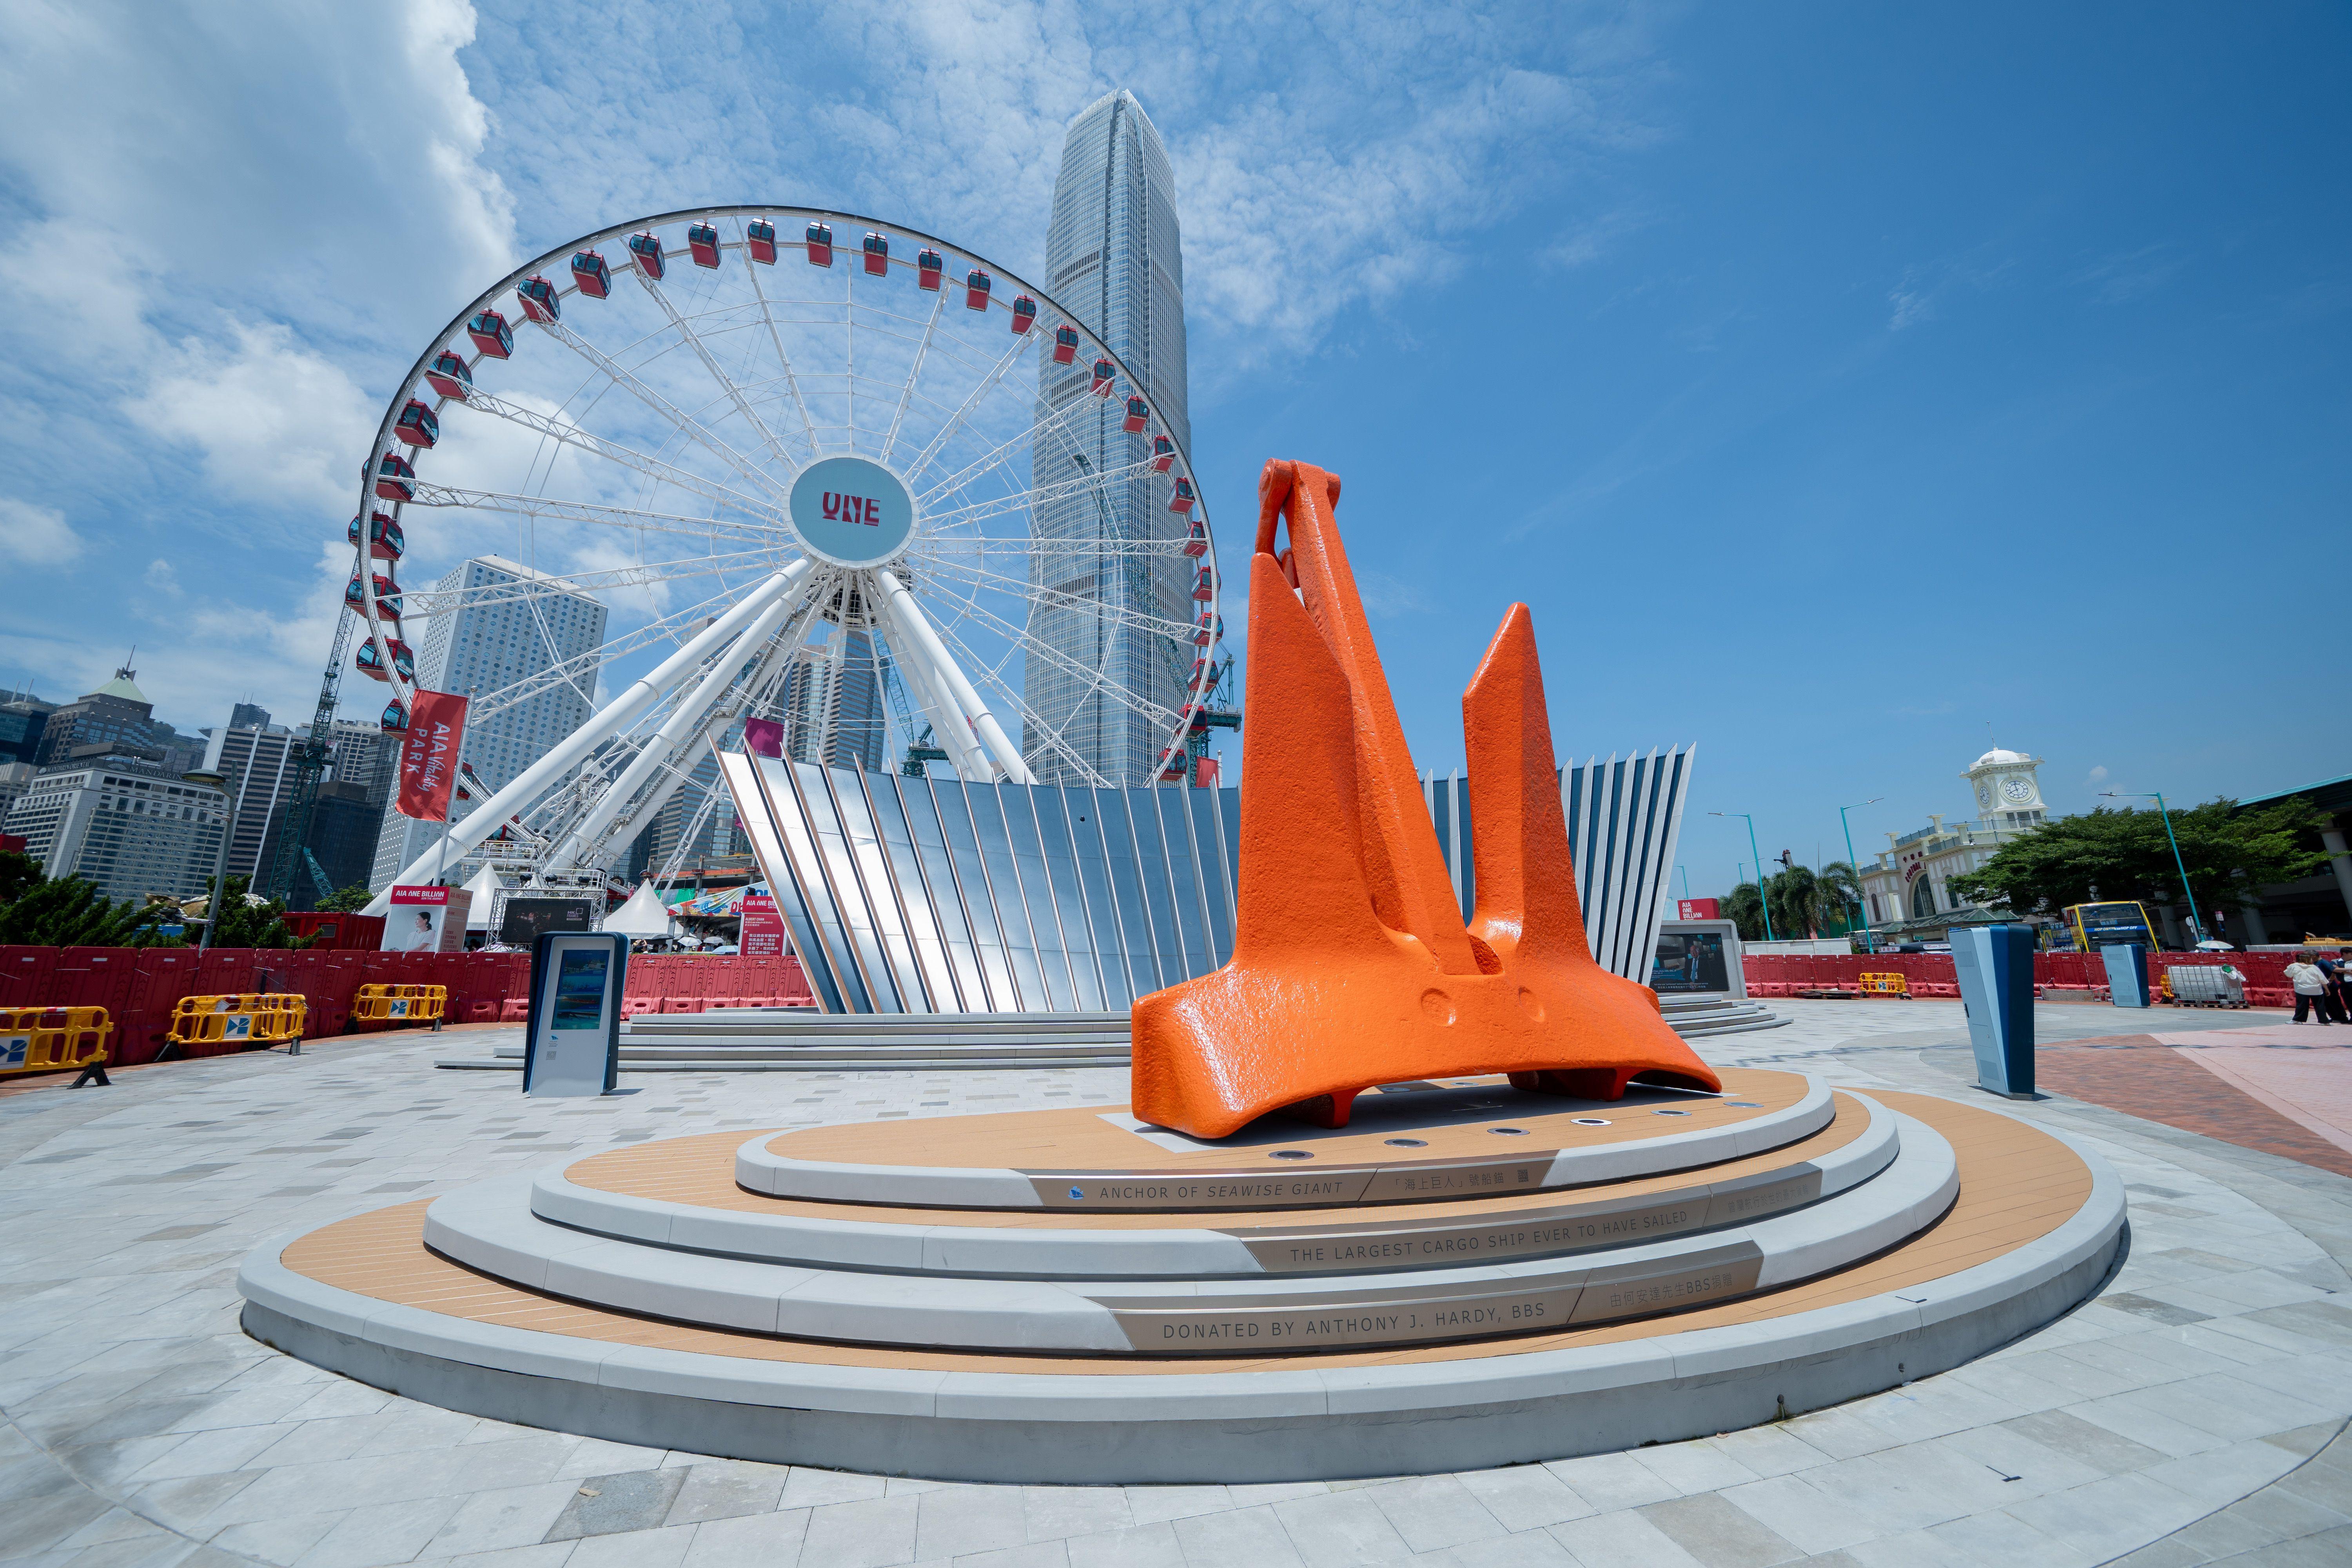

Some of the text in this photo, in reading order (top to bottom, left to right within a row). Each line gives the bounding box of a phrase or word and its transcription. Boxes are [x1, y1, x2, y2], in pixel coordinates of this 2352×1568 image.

[407, 728, 429, 774] PARK
[416, 721, 450, 791] AIA Vitality
[129, 766, 182, 780] MANDARIN
[1100, 1182, 1343, 1198] ANCHOR OF SEAWISE GIANT
[1396, 1172, 1504, 1191] 「海上巨人」號船錨
[1290, 1211, 1687, 1262] THE LARGEST CARGO SHIP EVER TO HAVE SAILED
[1610, 1272, 1732, 1308] 由何安達先生BBS捐贈
[1163, 1302, 1544, 1339] DONATED BY ANTHONY J. HARDY, BBS
